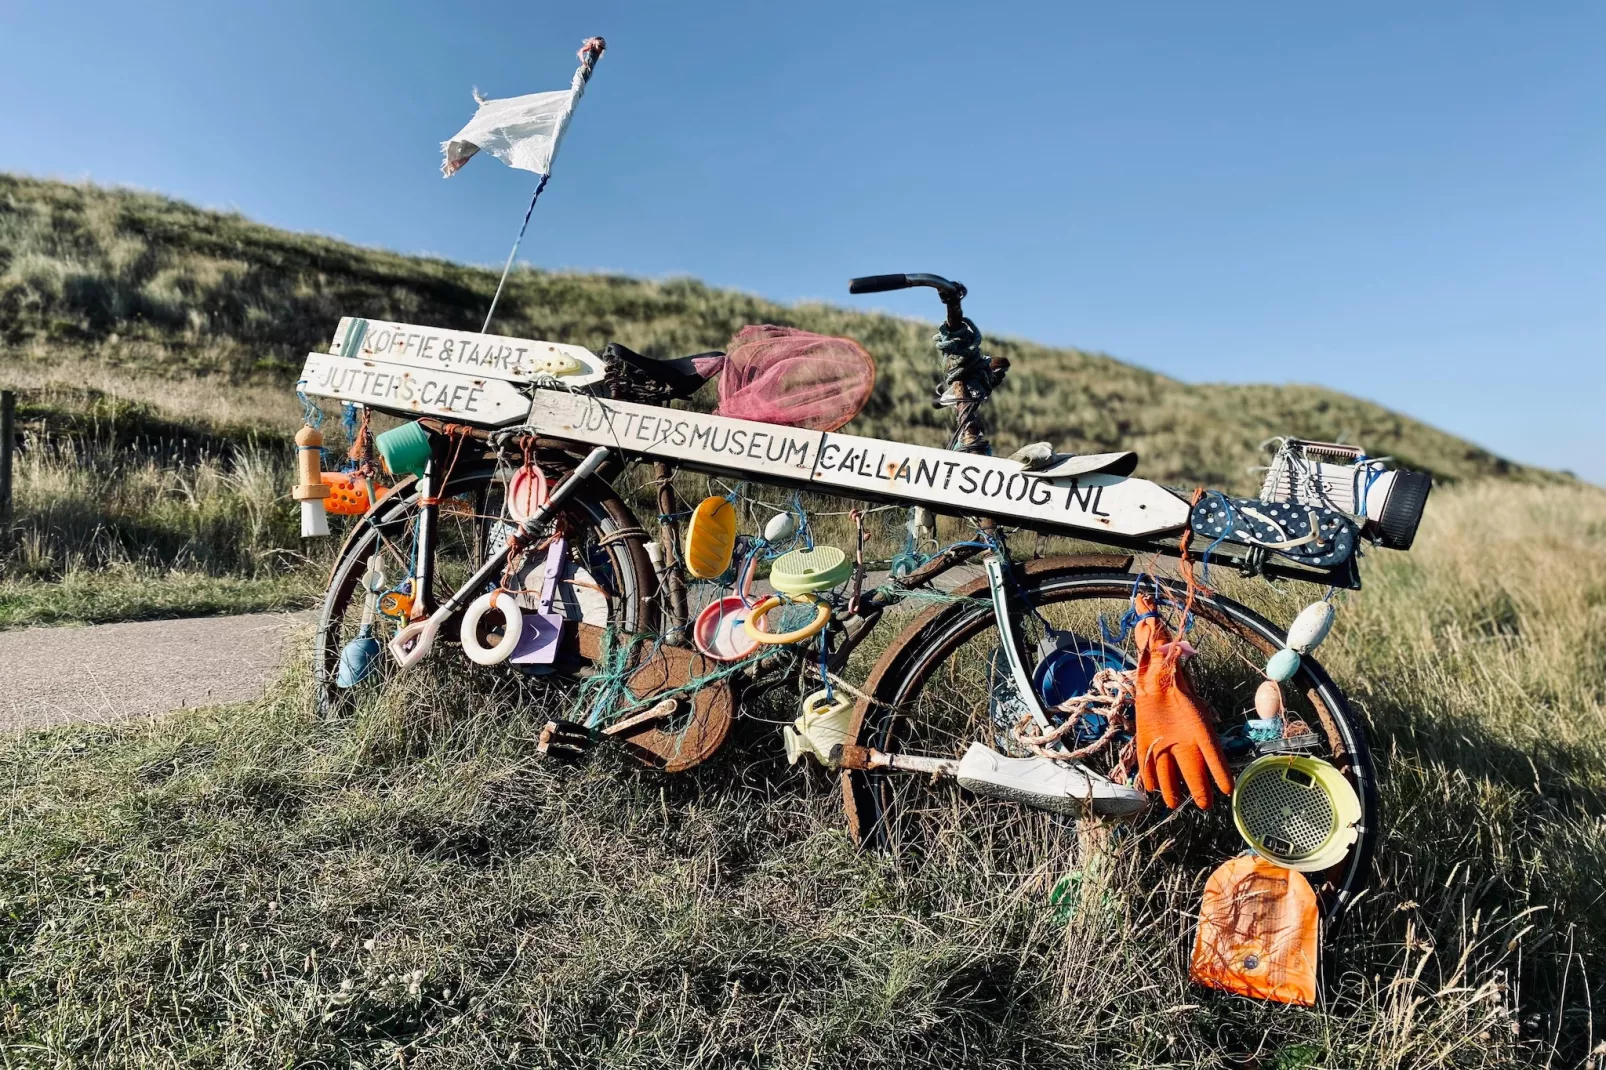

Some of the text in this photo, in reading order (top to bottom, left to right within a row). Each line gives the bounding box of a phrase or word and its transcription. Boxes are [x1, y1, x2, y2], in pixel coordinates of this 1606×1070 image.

[361, 328, 529, 370] KOFFIE & TAART
[572, 406, 810, 466] JUTTERSMUSEUM
[818, 443, 1110, 517] CALLANTSOOG NL
